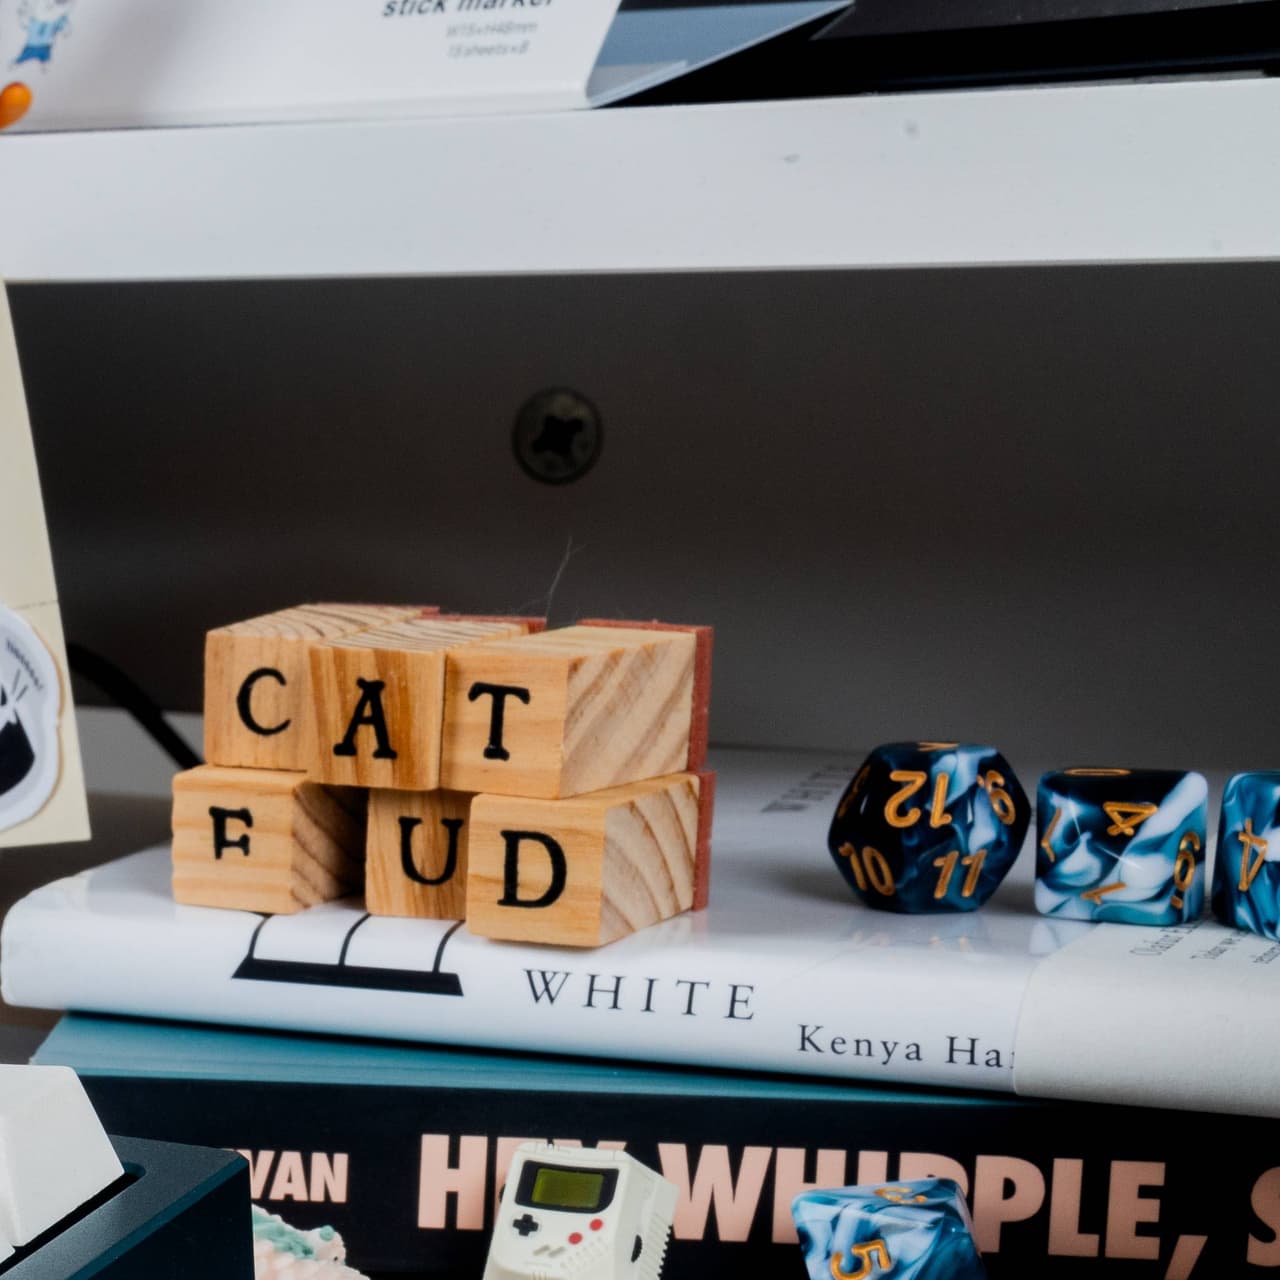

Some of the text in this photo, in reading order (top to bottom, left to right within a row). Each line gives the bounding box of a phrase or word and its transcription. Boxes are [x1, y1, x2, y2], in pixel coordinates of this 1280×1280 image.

[237, 667, 531, 761] CAT
[838, 842, 895, 896] 10
[933, 849, 987, 898] 11
[523, 968, 757, 1022] WHITE
[797, 1024, 1016, 1071] Kenya Ha
[230, 1148, 349, 1203] VAN
[658, 1143, 1208, 1280] WHPLE,
